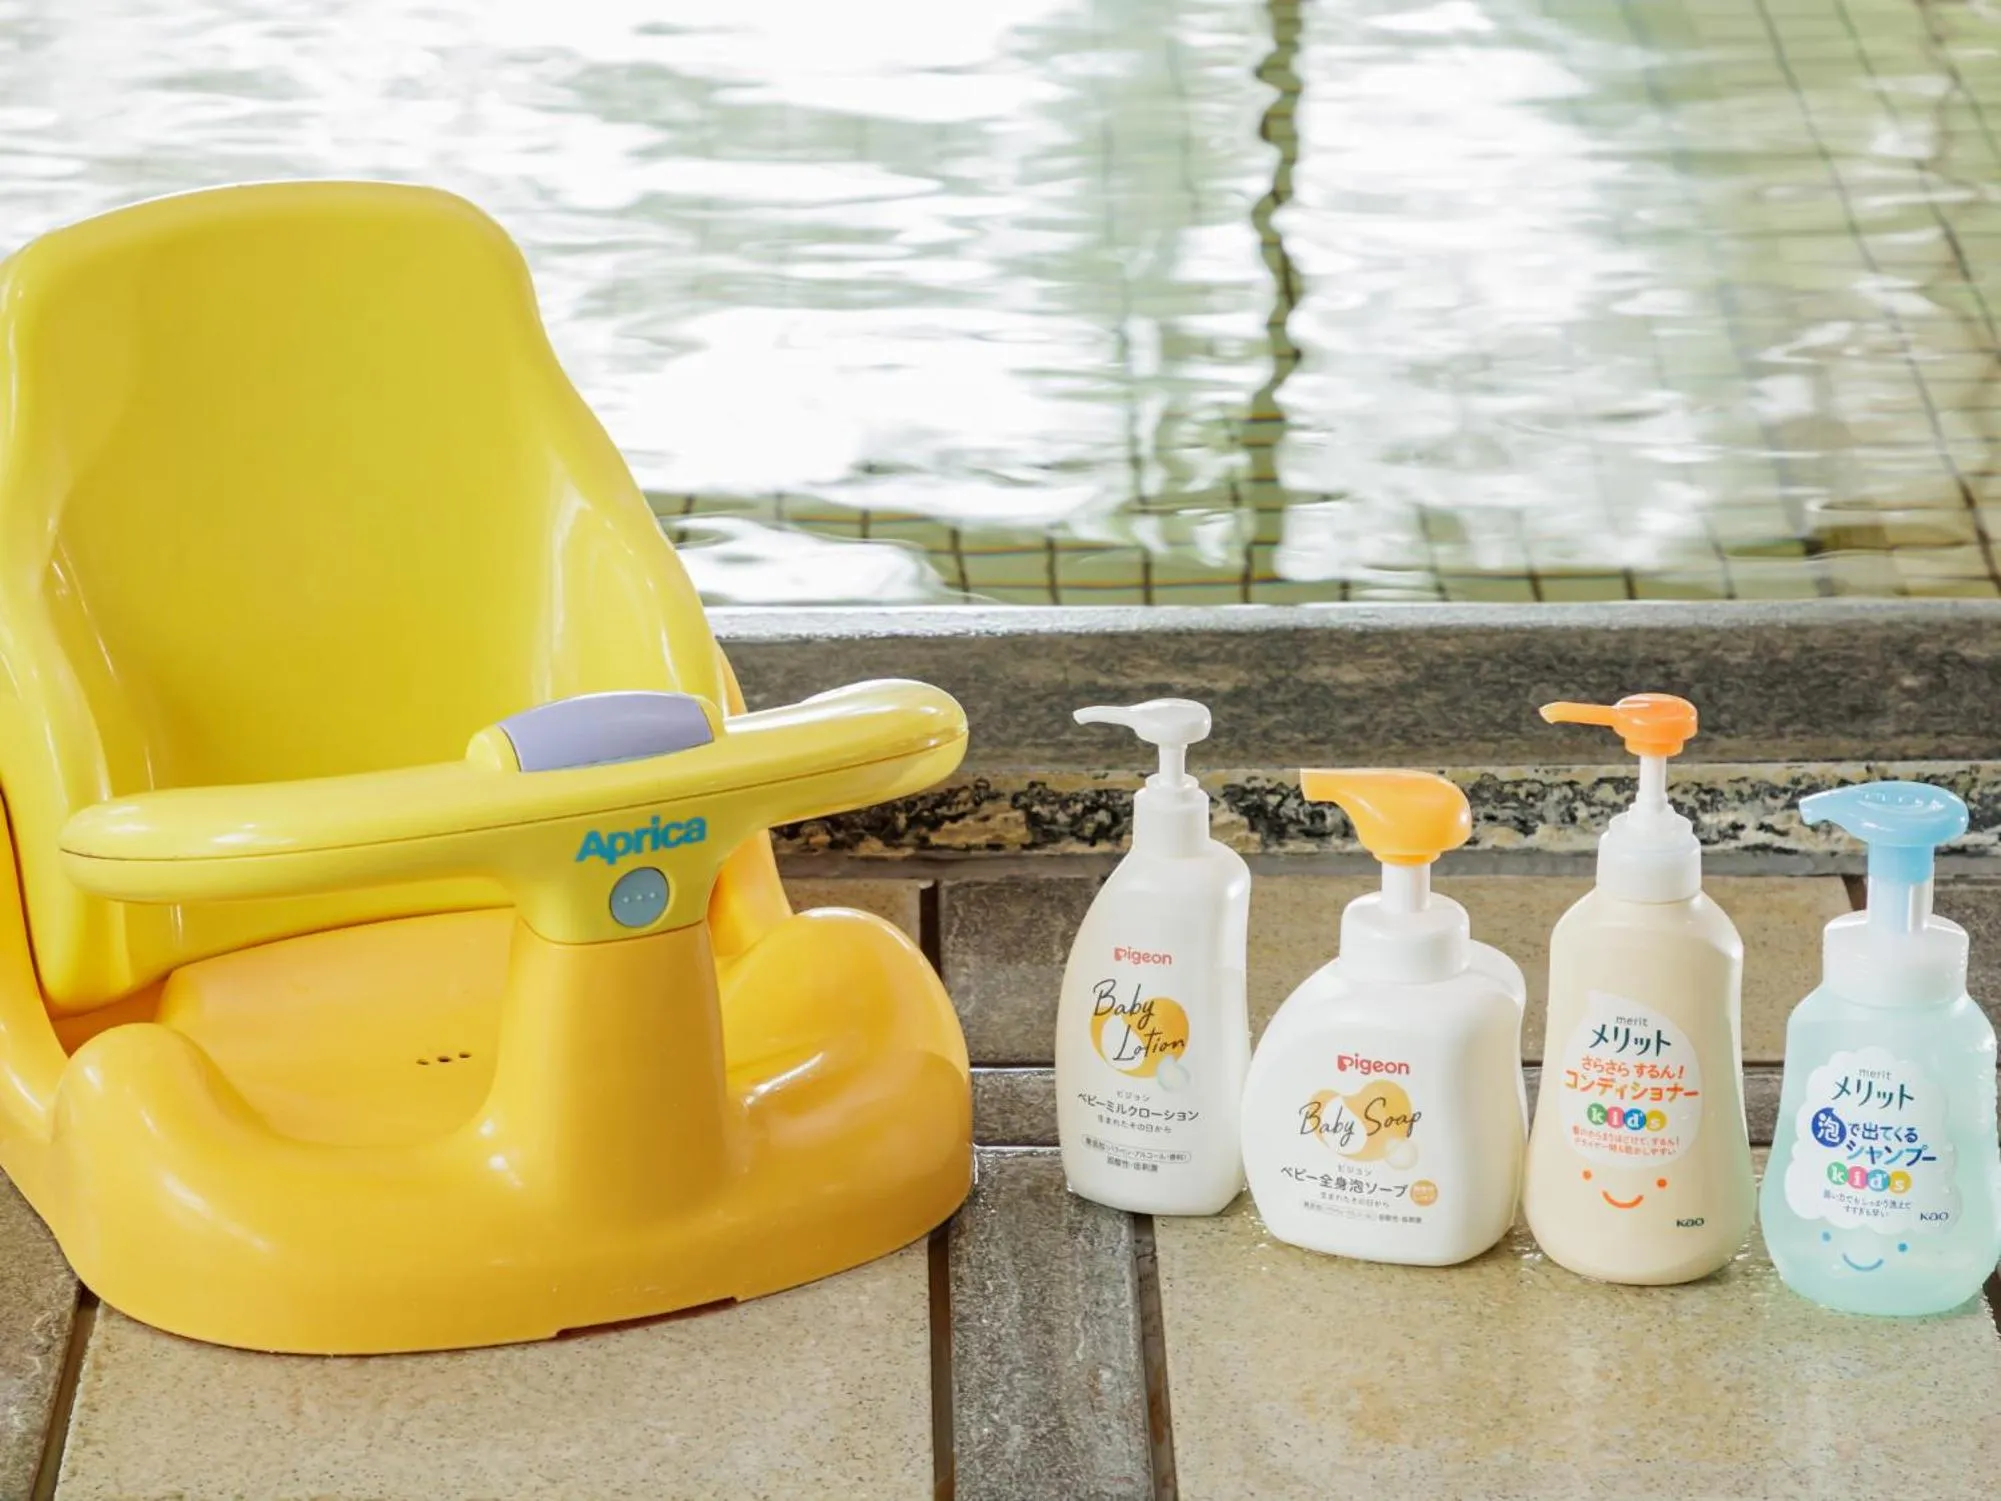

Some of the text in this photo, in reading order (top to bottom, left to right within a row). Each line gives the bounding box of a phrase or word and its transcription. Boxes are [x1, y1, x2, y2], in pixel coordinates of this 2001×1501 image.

[575, 815, 706, 865] Aprica
[1114, 946, 1172, 965] Pigeon
[1093, 979, 1154, 1030] Baby
[1616, 1016, 1648, 1027] merit
[1113, 1024, 1185, 1060] Lotion
[1589, 1024, 1671, 1056] メリット
[1337, 1053, 1410, 1075] Pigeon
[1859, 1069, 1891, 1080] merit
[1565, 1070, 1699, 1102] コンディショナー
[1831, 1076, 1914, 1111] メリット
[1077, 1092, 1199, 1121] ベビーミルクローション
[1299, 1097, 1422, 1147] Baby Soap
[1590, 1105, 1663, 1130] kids
[1815, 1110, 1918, 1145] 泡で出てくる
[1846, 1140, 1936, 1167] シャンプー
[1281, 1166, 1408, 1198] ベビー全身泡ソープ
[1830, 1164, 1908, 1192] kids
